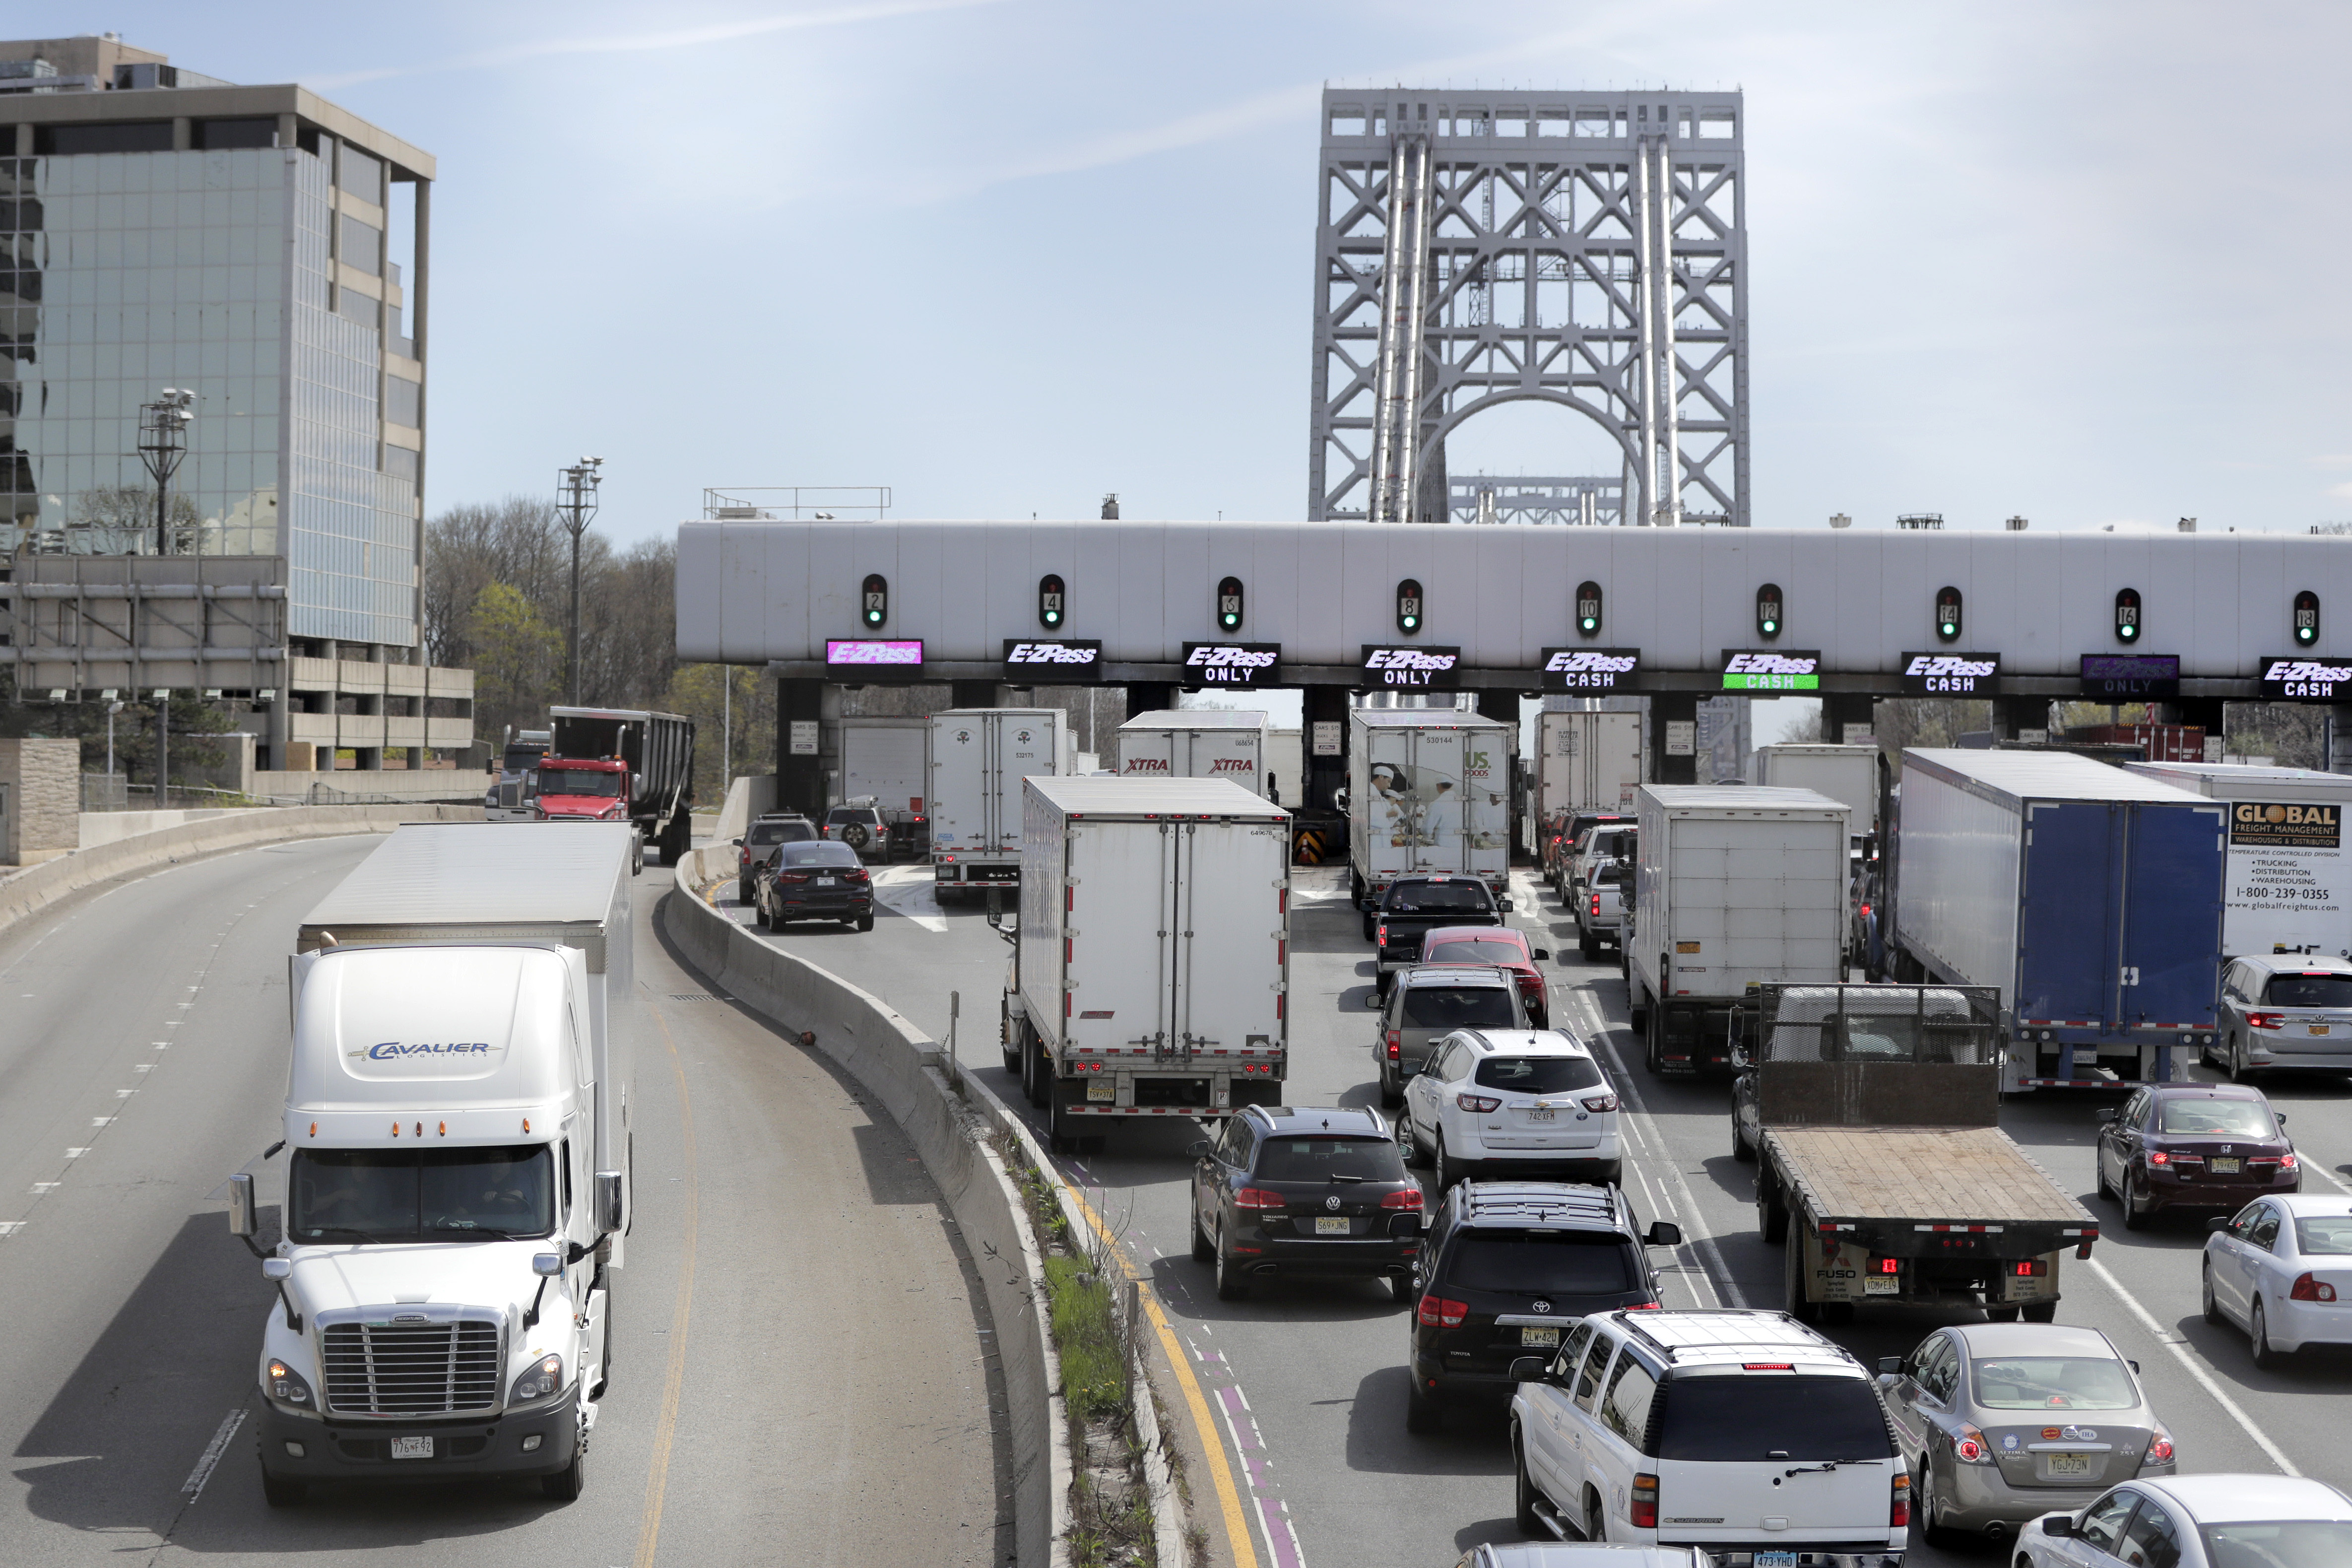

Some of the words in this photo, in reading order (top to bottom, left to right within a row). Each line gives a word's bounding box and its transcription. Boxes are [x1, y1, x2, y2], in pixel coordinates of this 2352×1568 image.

[871, 594, 879, 609] 2
[1048, 595, 1056, 609] 4
[1227, 597, 1235, 611] 6
[1405, 599, 1413, 614] 8
[1581, 601, 1595, 616] 10
[1762, 604, 1775, 619] 12
[1942, 607, 1955, 622] 14
[2121, 609, 2133, 624] 16
[2300, 611, 2312, 626] 18
[831, 644, 920, 662] E-ZPass
[1008, 644, 1096, 663] E-ZPass
[1186, 647, 1277, 667] E-ZPass
[1366, 650, 1456, 670] E-ZPass
[1545, 652, 1636, 672] E-ZPass
[1725, 653, 1817, 674] E-ZPass
[1905, 656, 1996, 677] E-ZPass
[1205, 668, 1253, 682] ONLY
[1384, 671, 1432, 684] ONLY
[2264, 661, 2352, 682] E-ZPass
[1566, 673, 1614, 687] CASH
[1746, 675, 1794, 689] CASH
[1926, 677, 1974, 691] CASH
[2104, 680, 2152, 692] ONLY
[2285, 682, 2332, 696] CASH
[1123, 758, 1168, 774] XTRA
[1208, 758, 1253, 774] XTRA
[2235, 824, 2271, 833] FREIGHT
[2275, 825, 2336, 835] MANAGEMENT
[2235, 836, 2282, 844] WAREHOUSING
[2292, 838, 2336, 846] DISTRIBUTION
[2236, 887, 2329, 899] 1-800-239-0355
[2226, 902, 2340, 912] www.globalfreightus.com
[369, 1042, 489, 1060] CAVALIER
[1817, 1270, 1856, 1279] FUSO
